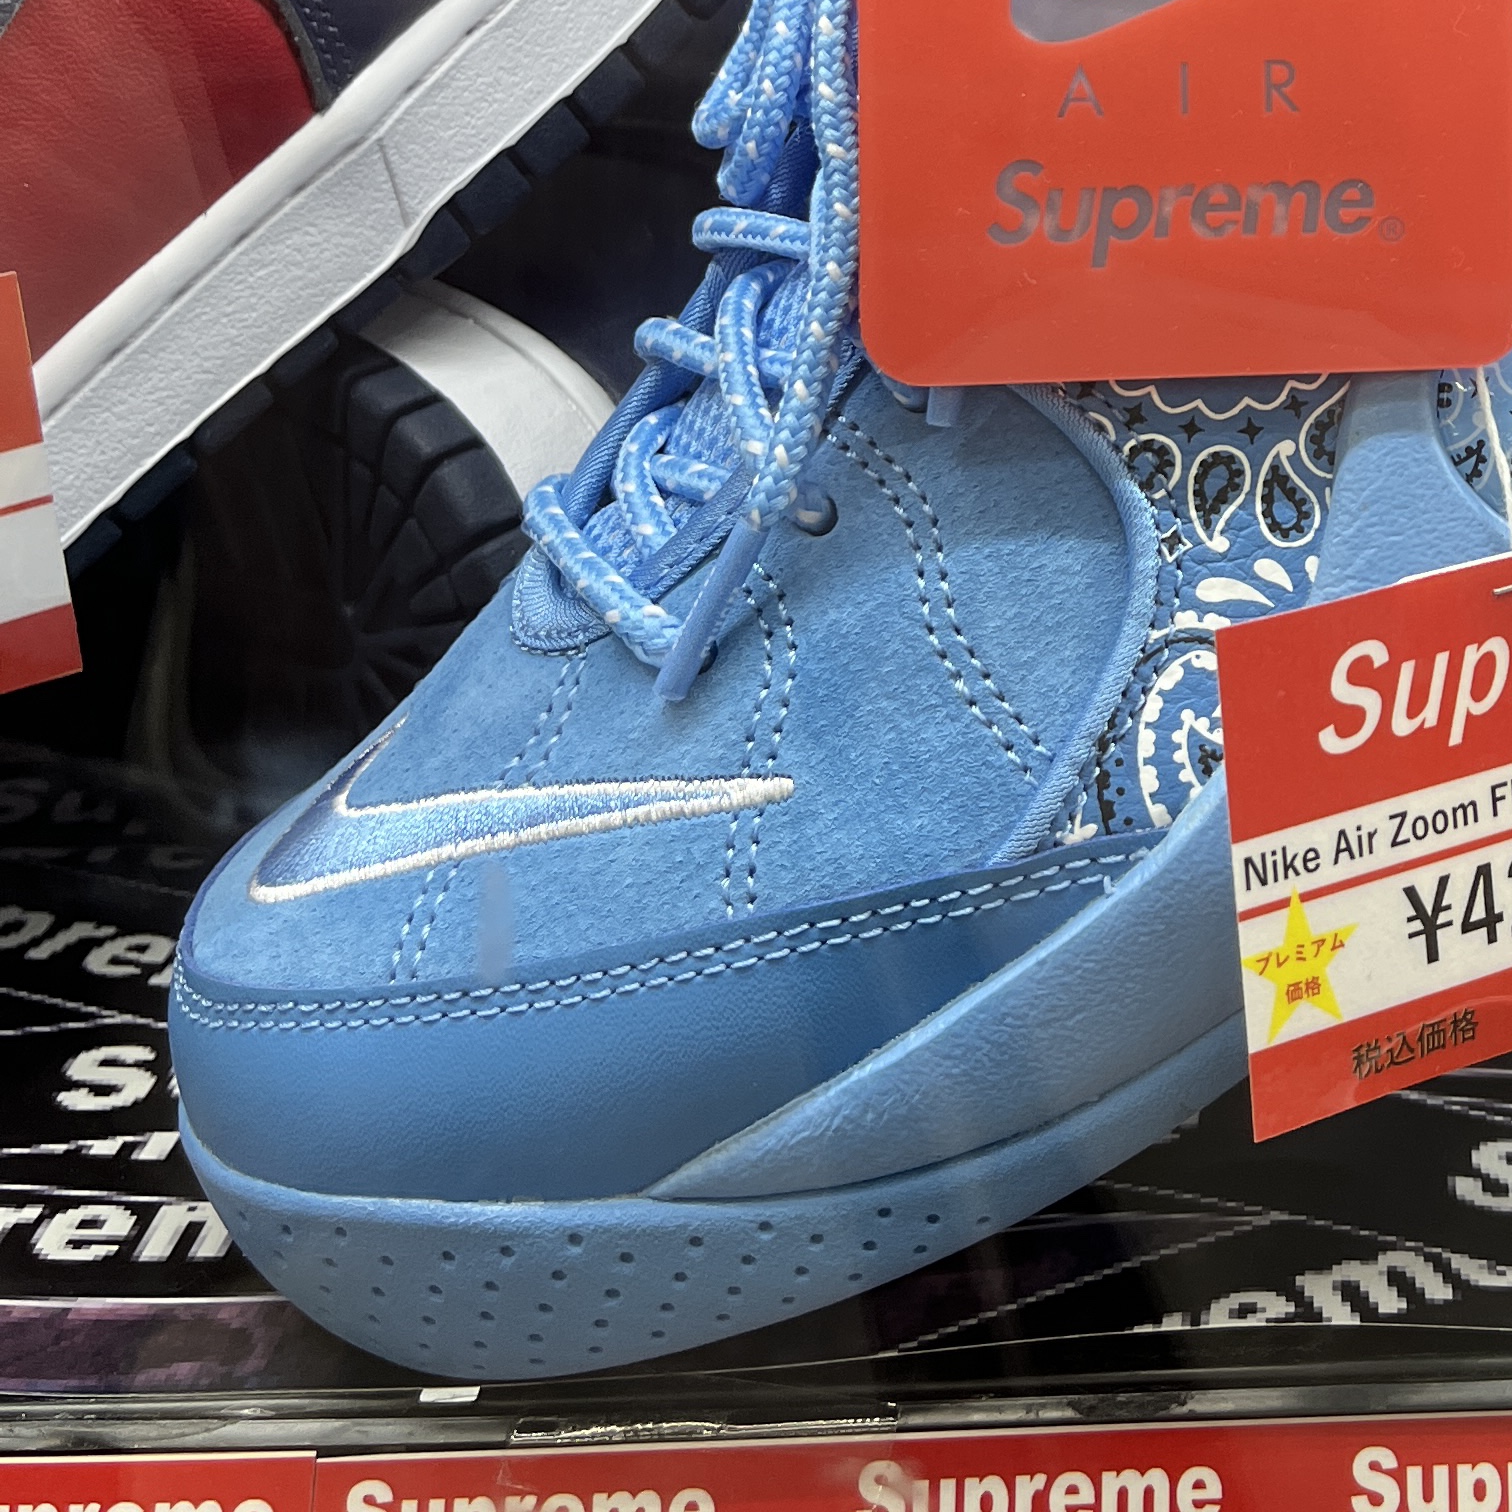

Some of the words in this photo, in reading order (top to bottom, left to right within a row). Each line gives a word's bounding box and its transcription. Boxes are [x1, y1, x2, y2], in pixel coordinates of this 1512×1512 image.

[985, 158, 1376, 270] Supreme
[1243, 843, 1322, 892] Nike
[1332, 825, 1378, 867] Air
[1388, 798, 1480, 850] Zoom
[1255, 934, 1346, 976] プレミアム
[1284, 975, 1324, 1005] 価格
[1350, 1008, 1481, 1081] 税込価格
